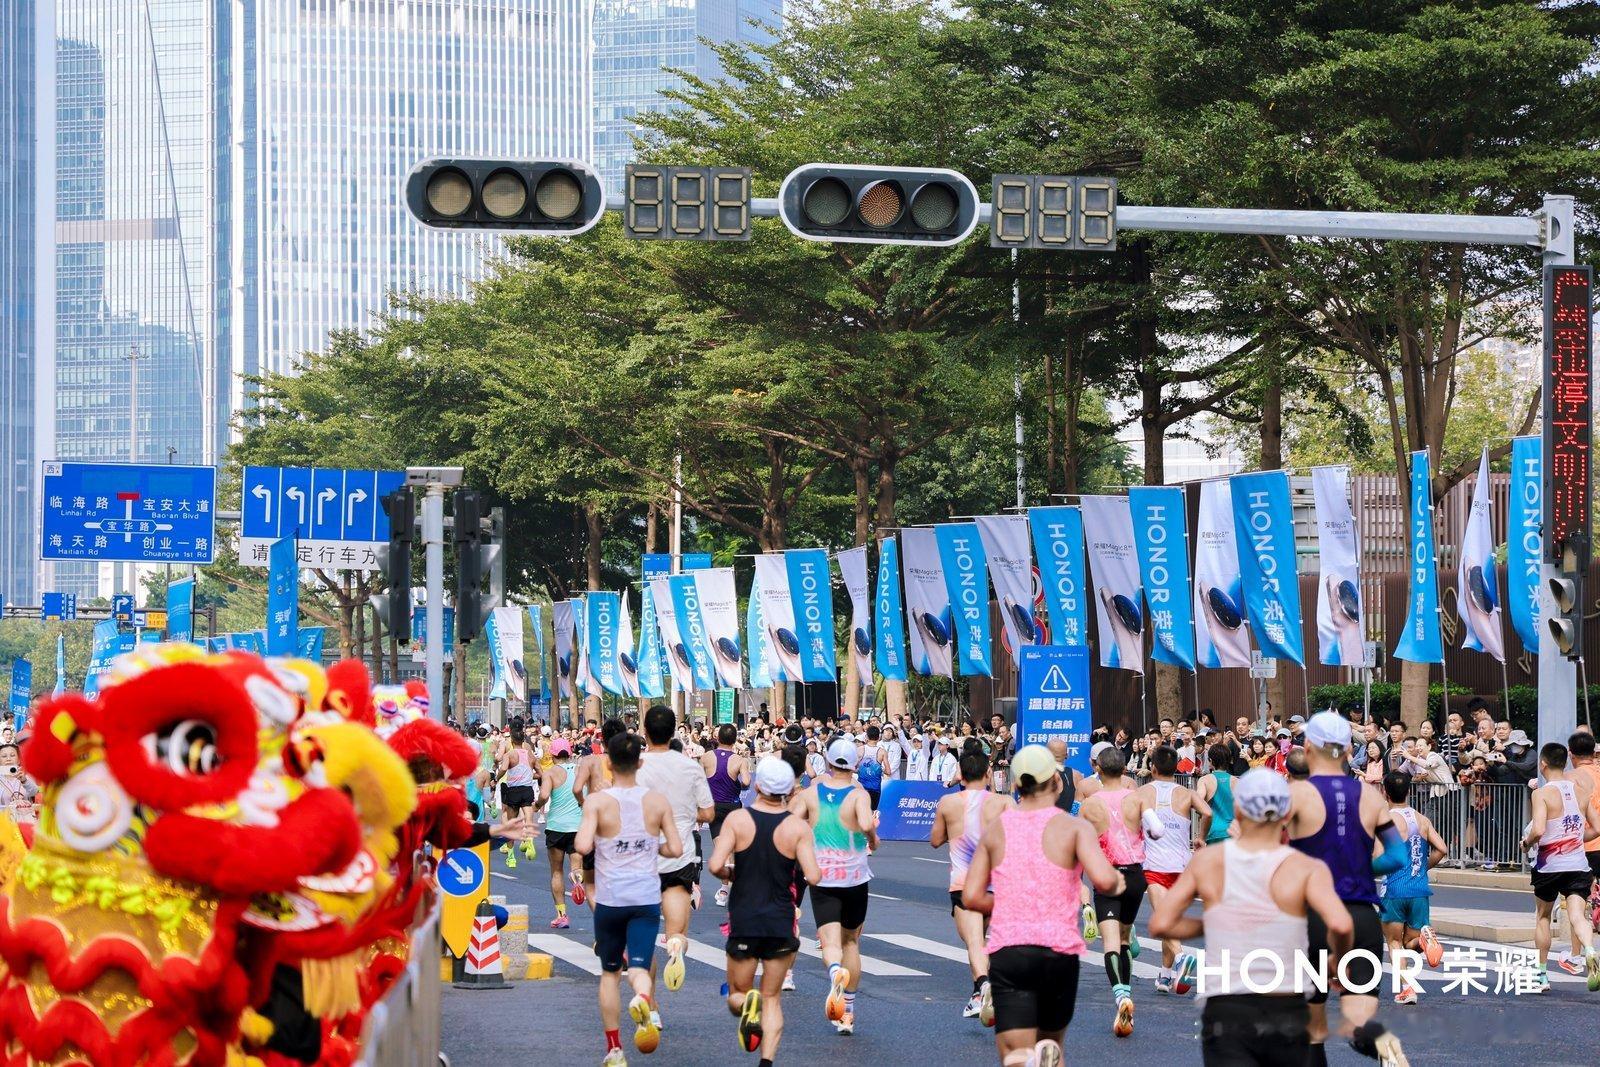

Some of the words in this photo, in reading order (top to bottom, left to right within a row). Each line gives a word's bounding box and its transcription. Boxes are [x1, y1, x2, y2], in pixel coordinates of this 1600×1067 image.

[50, 496, 109, 510] 临海路
[107, 521, 150, 532] 宝华路
[143, 499, 209, 513] 宝安大道
[49, 534, 108, 548] 海天路
[142, 537, 208, 551] 创业一路
[252, 544, 378, 565] 请定行车方
[1147, 505, 1170, 603] HONOR
[1249, 491, 1280, 593] HONOR
[880, 552, 891, 628] HONOR
[952, 539, 980, 621] HONOR
[1048, 523, 1077, 612] HONOR
[682, 584, 702, 647] HONOR
[800, 562, 822, 634] HONOR
[1262, 598, 1285, 645] 荣耀
[598, 602, 612, 657] HONOR
[642, 599, 657, 657] HONOR
[1028, 697, 1085, 710] 温馨提示
[1042, 720, 1073, 729] 终点前
